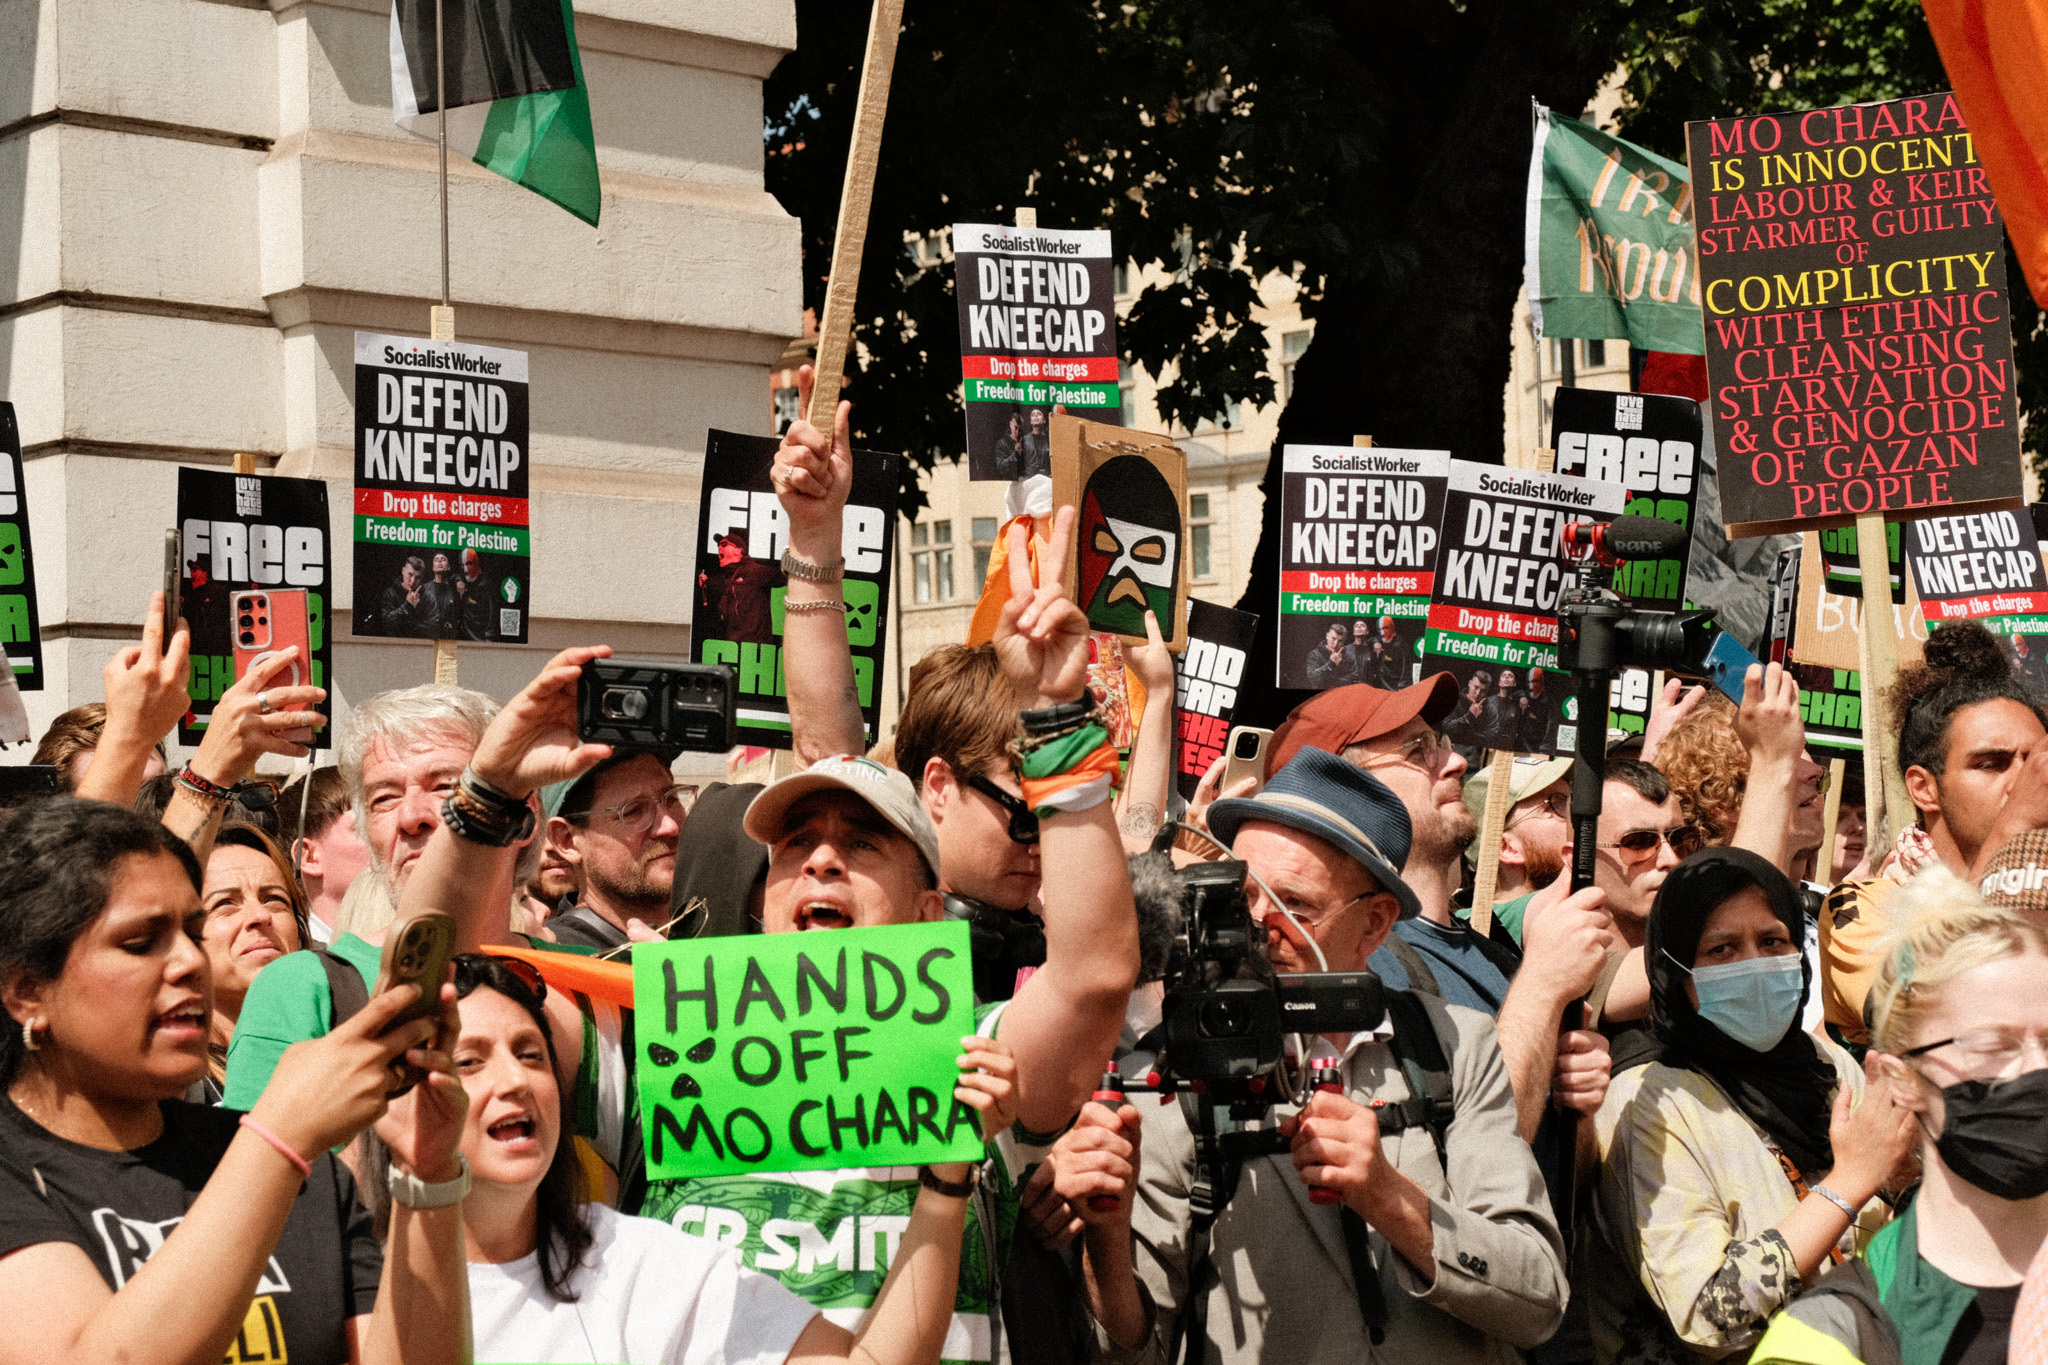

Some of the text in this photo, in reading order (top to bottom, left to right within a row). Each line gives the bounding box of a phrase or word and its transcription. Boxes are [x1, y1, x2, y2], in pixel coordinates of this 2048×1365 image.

[1707, 94, 1968, 157] MO CHARA
[1709, 132, 1977, 192] IS INNOCENT
[1709, 167, 1992, 224] LABOUR & KEIR
[982, 233, 1082, 255] Socialist Worker
[1700, 198, 1997, 256] STARMER GUILTY
[1835, 241, 1870, 265] OF
[977, 257, 1091, 306] DEFEND
[1705, 251, 1996, 316] COMPLICITY
[968, 304, 1106, 353] KNEECAP
[1714, 290, 2000, 350] WITH ETHNIC
[384, 345, 501, 375] Socialist Worker
[990, 357, 1088, 381] Drop the charges
[1734, 326, 1985, 385] CLEANSING
[377, 373, 508, 434] DEFEND
[976, 380, 1106, 405] Freedom for Palestine
[1718, 358, 2007, 420] STARVATION
[1729, 393, 2005, 454] & GENOCIDE
[364, 427, 520, 490] KNEECAP
[1312, 454, 1420, 473] Socialist Worker
[1750, 432, 1979, 485] OF GAZAN
[383, 491, 502, 522] Drop the charges
[1304, 477, 1426, 522] DEFEND
[1479, 473, 1595, 506] Socialist Worker
[1790, 470, 1953, 519] PEOPLE
[365, 518, 518, 551] Freedom for Palestine
[1291, 522, 1437, 567] KNEECAP
[1915, 511, 2020, 553] DEFEND
[1309, 572, 1417, 593] Drop the charges
[1443, 549, 1590, 611] KNEECA
[1612, 559, 1682, 600] ARA
[1915, 550, 2037, 594] KNEECAP
[1292, 594, 1430, 617] Freedom for Palestine
[1458, 610, 1559, 643] Drop the charg
[1940, 595, 2033, 618] Drop the charges
[701, 638, 875, 708] CHA
[1437, 633, 1559, 669] Freedom for Pales
[662, 947, 956, 1034] HANDS
[1284, 1002, 1316, 1011] Canon
[732, 1026, 873, 1087] OFF
[652, 1086, 983, 1165] MO CHARA
[754, 1215, 911, 1274] SMIT
